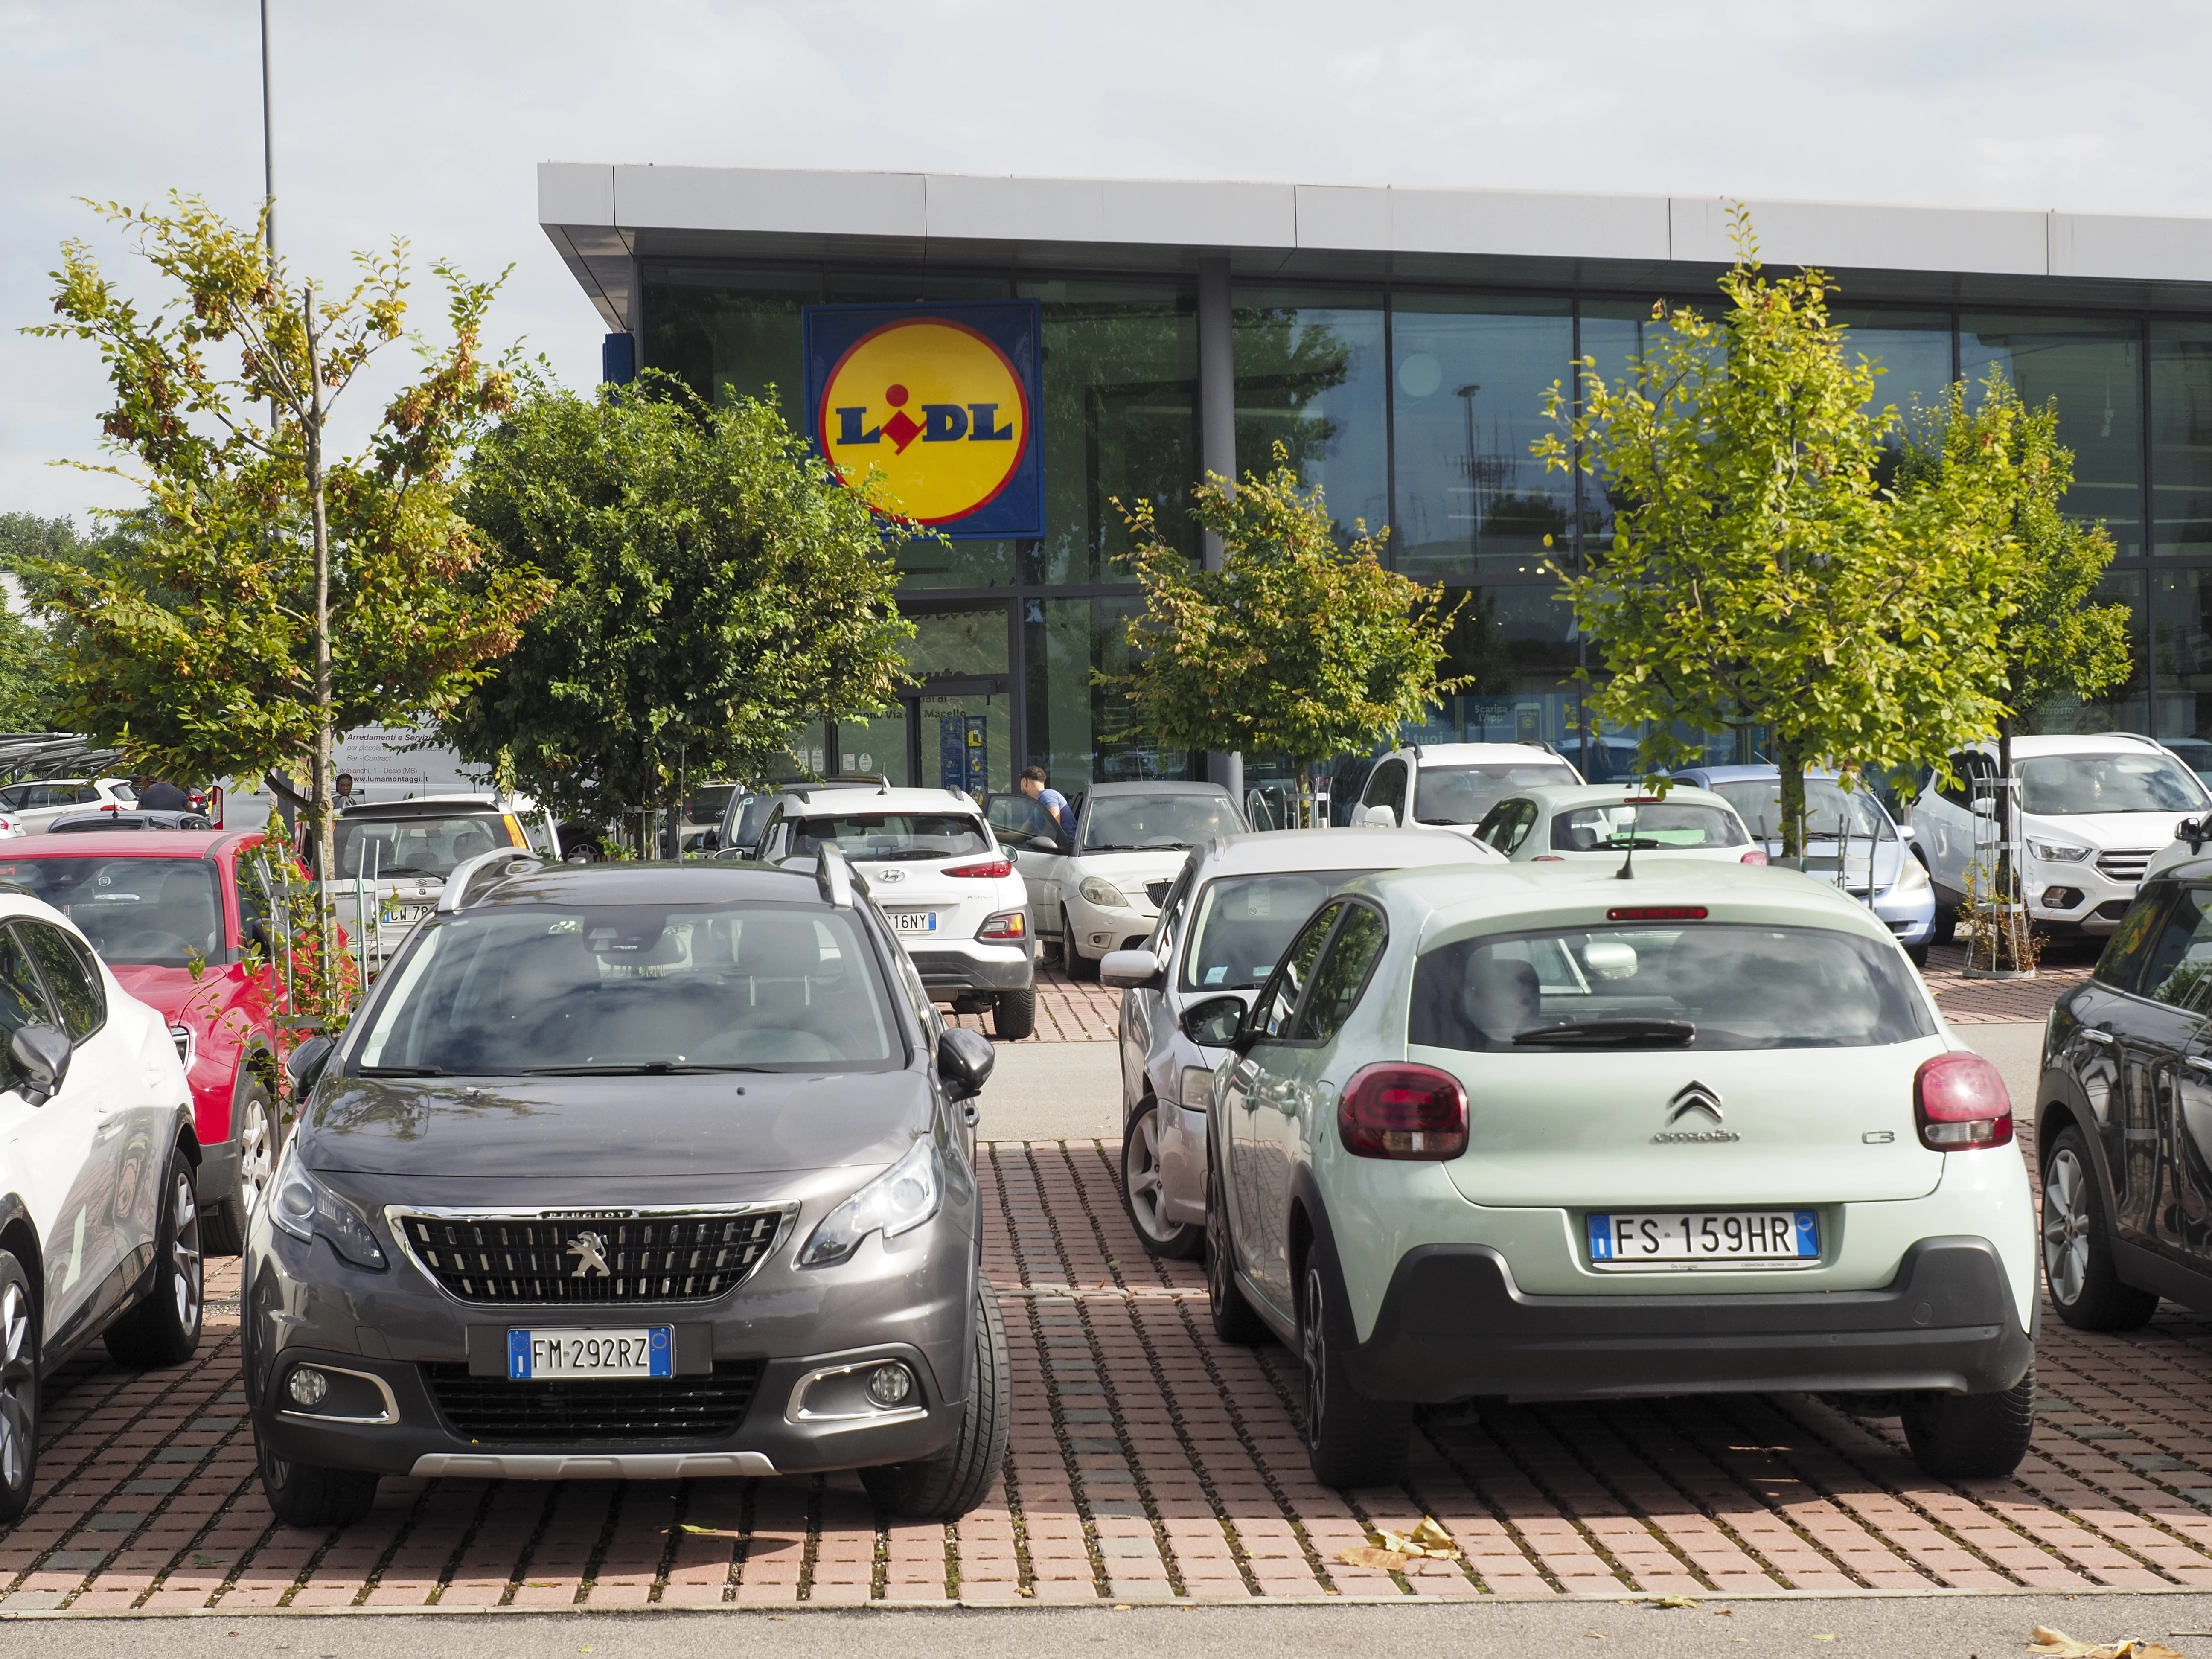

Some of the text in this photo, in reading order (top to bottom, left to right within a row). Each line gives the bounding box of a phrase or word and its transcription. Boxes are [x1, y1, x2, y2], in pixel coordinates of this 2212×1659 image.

[885, 709, 902, 719] Via
[924, 709, 966, 718] Macello
[1475, 704, 1508, 713] Scarica
[1479, 713, 1503, 723] l'App
[1413, 731, 1443, 744] tuoi
[888, 915, 926, 929] 16NY
[1616, 1219, 1660, 1254] FS
[1680, 1216, 1792, 1253] 159HR
[533, 1339, 562, 1368] FM
[571, 1337, 649, 1368] 292RZ
